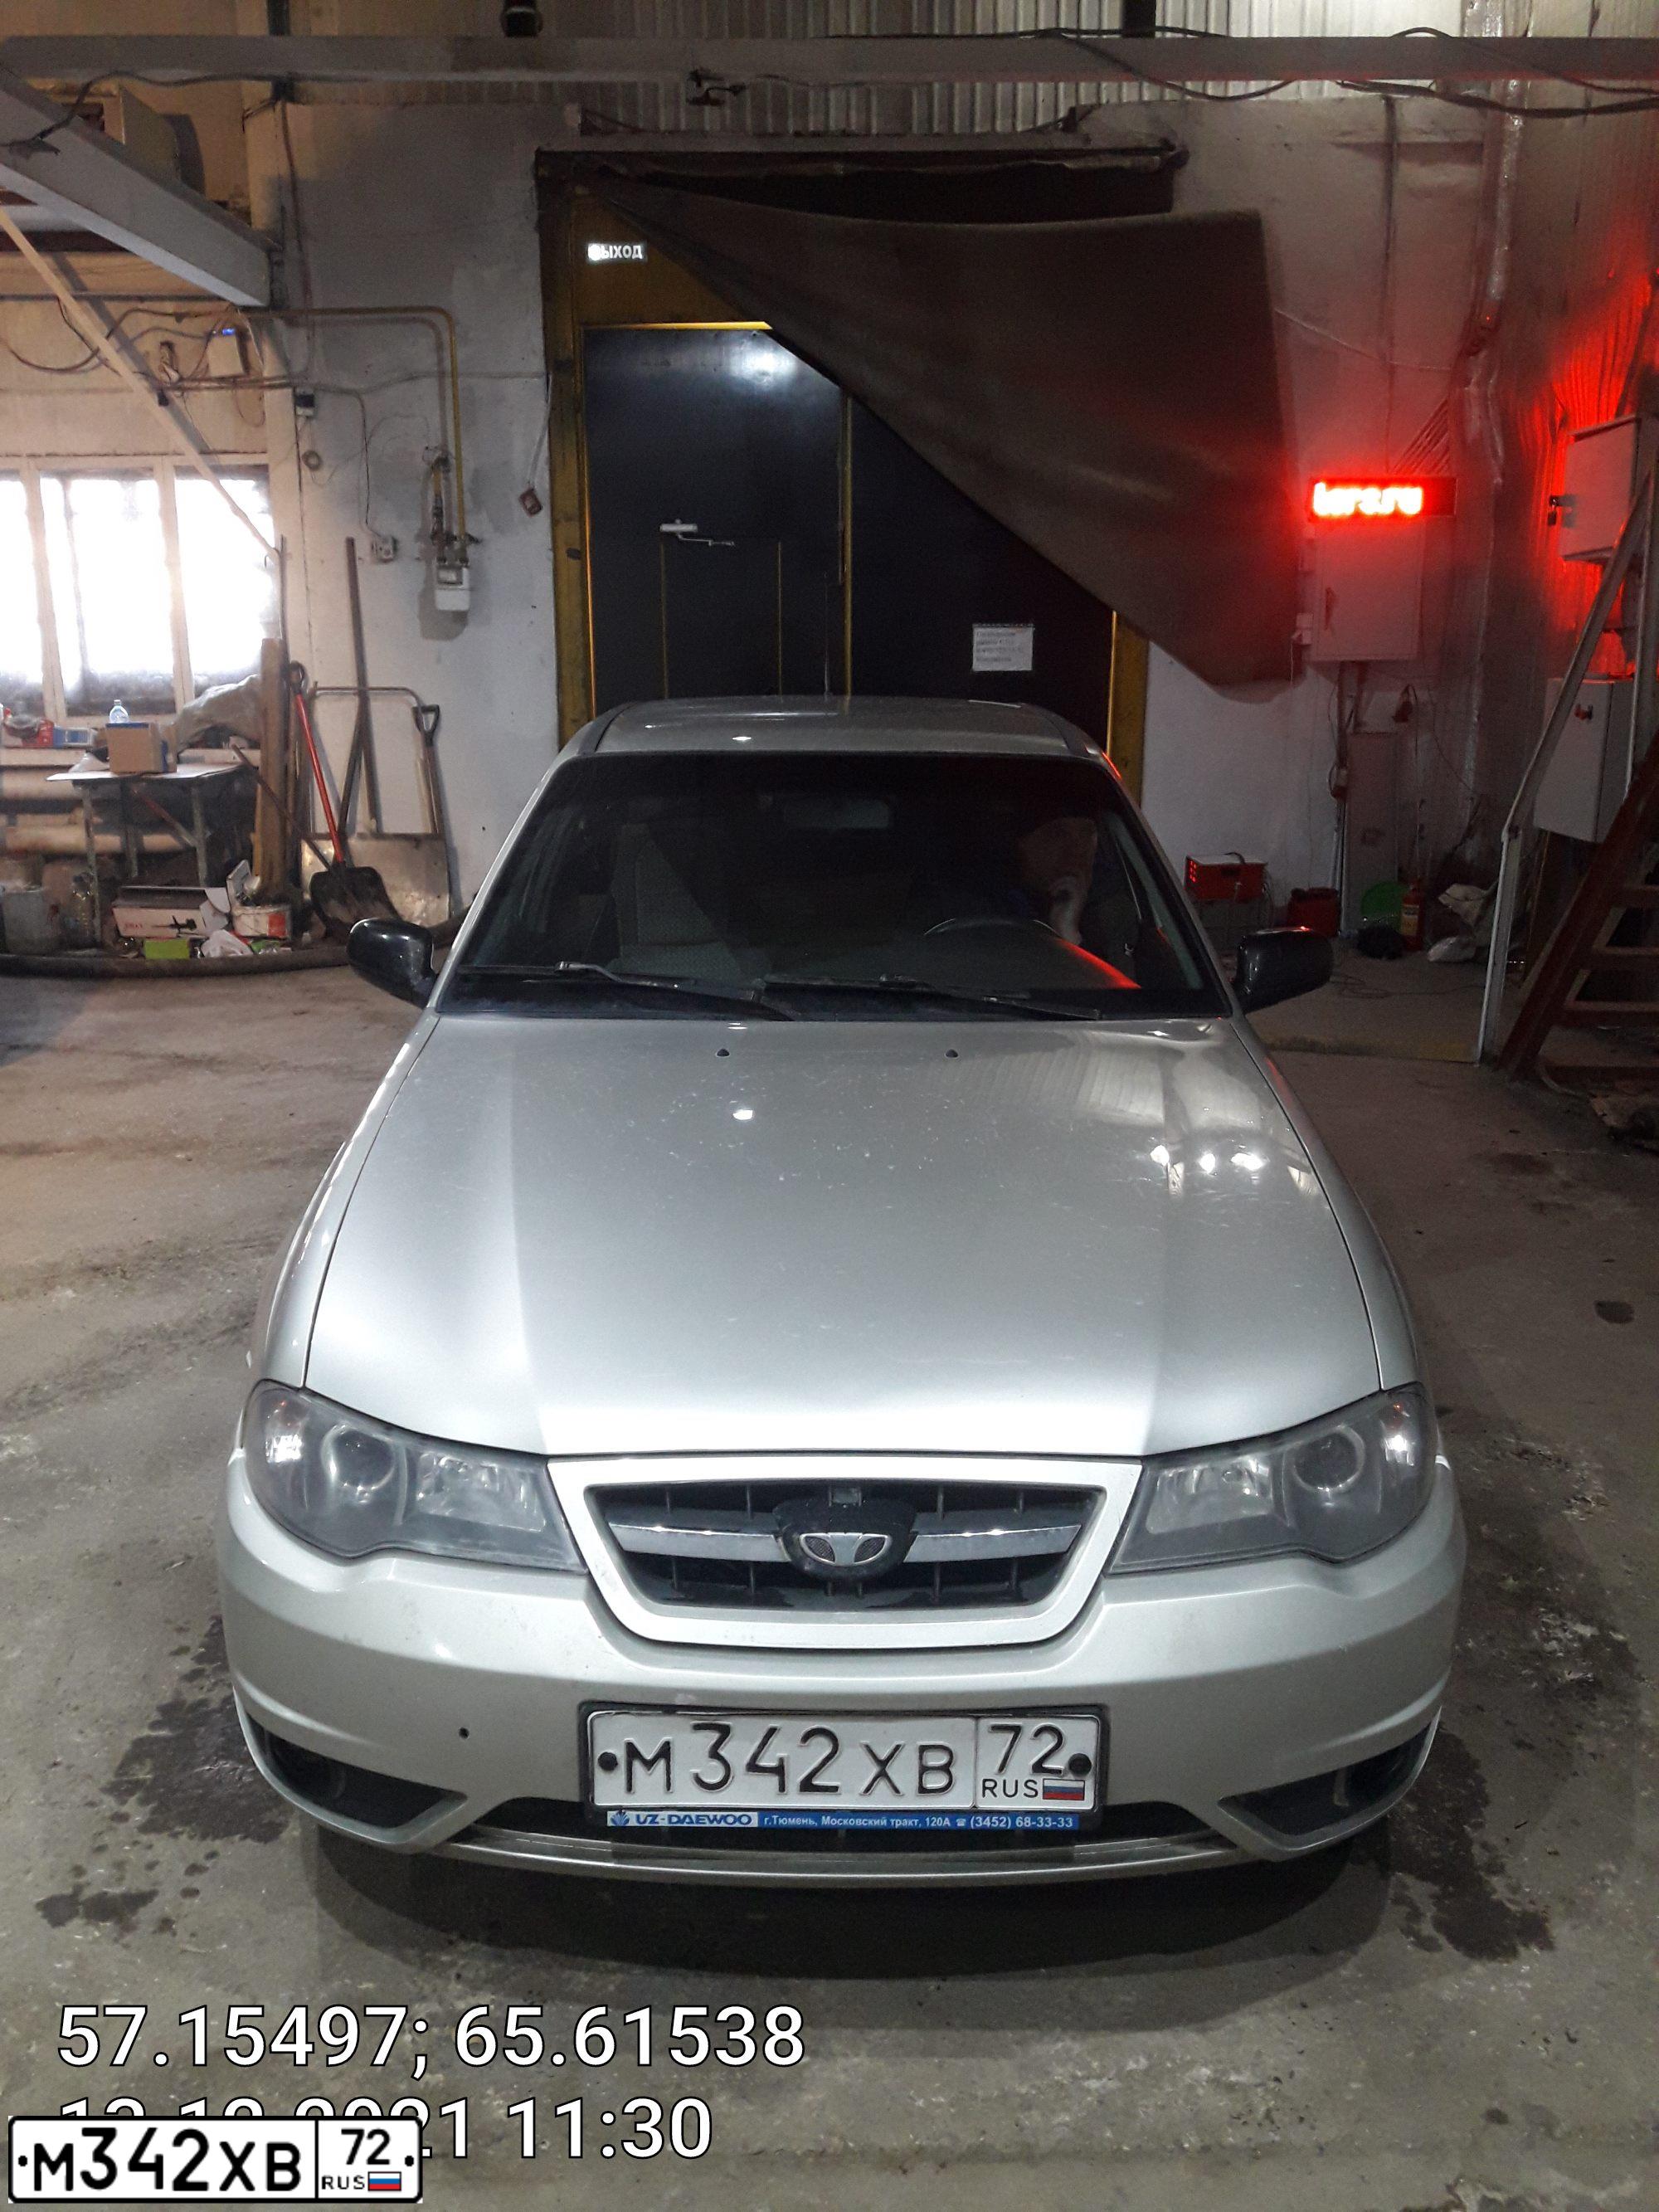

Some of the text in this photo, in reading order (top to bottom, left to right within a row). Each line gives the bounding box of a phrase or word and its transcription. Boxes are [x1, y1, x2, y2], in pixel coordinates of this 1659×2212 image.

[587, 244, 644, 261] ЫХОД
[990, 1724, 1065, 1776] 72
[981, 1778, 1040, 1798] RUS
[635, 1814, 752, 1825] UZ-DAEWOO
[763, 1815, 1073, 1829] г.Тюмень, Московский тракт, 120А (3452) 68-33-33
